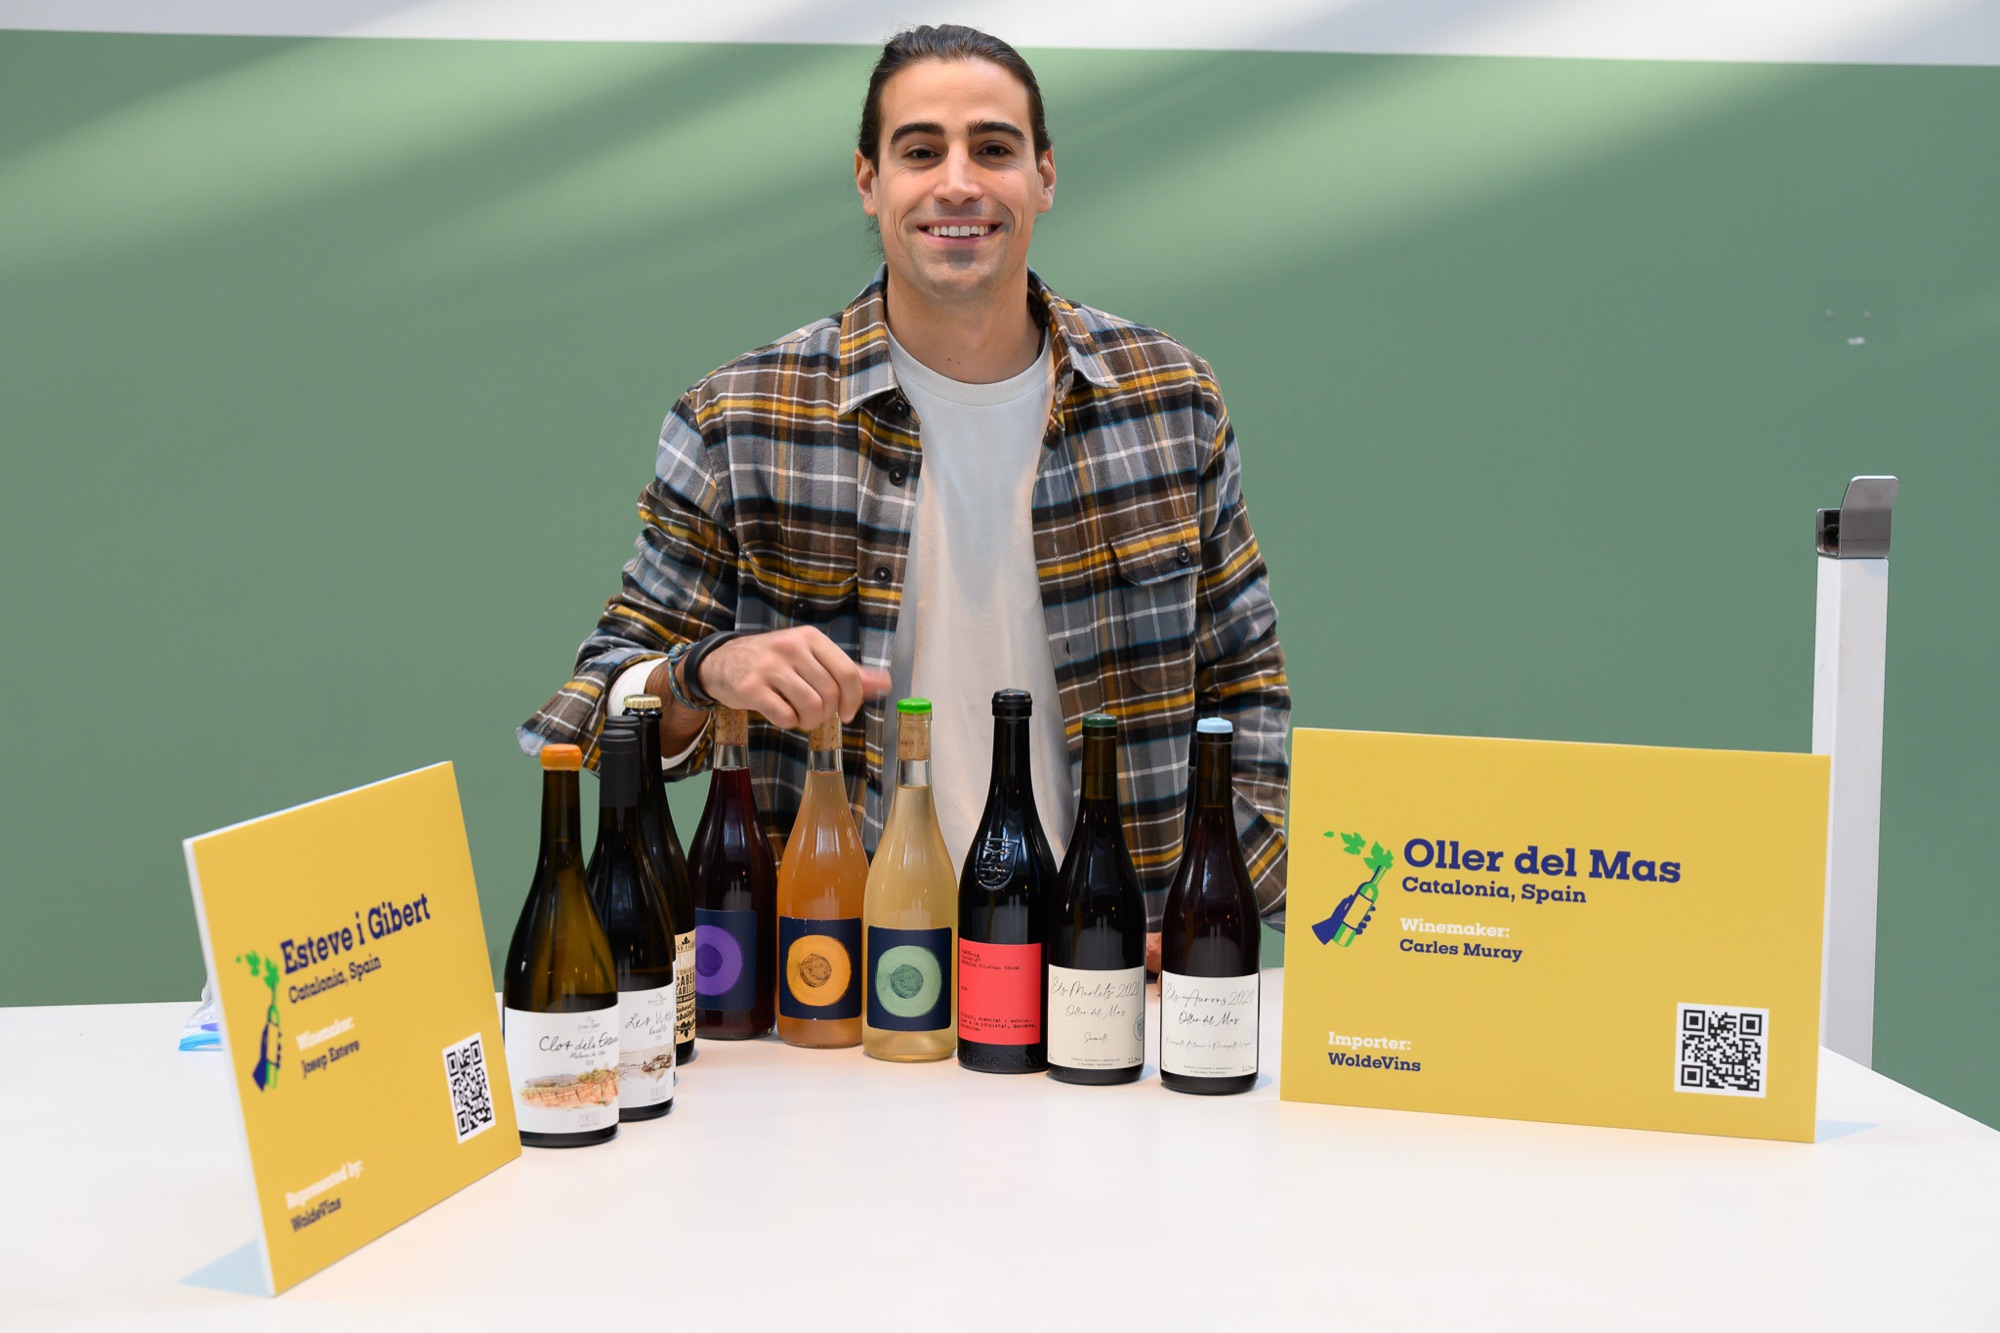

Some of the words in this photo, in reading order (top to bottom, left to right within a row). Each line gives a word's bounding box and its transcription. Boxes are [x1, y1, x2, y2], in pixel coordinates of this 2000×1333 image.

[1403, 838, 1503, 872] Oller
[1514, 845, 1577, 877] del
[1588, 849, 1681, 884] Mas
[1402, 876, 1516, 903] Catalonia,
[1521, 883, 1587, 905] Spain
[280, 927, 354, 975] Esteve
[355, 911, 365, 946] i
[368, 893, 431, 940] Gibert
[1400, 917, 1510, 938] Winemaker:
[1399, 938, 1459, 955] Carles
[1463, 942, 1523, 963] Muray
[288, 968, 348, 1004] Catalonia,
[349, 953, 382, 981] Spain
[328, 1040, 360, 1062] Esteve
[539, 1036, 573, 1052] Clot
[574, 1036, 597, 1051] dels
[1328, 1031, 1412, 1051] Importer:
[1328, 1052, 1421, 1072] WoldeVins
